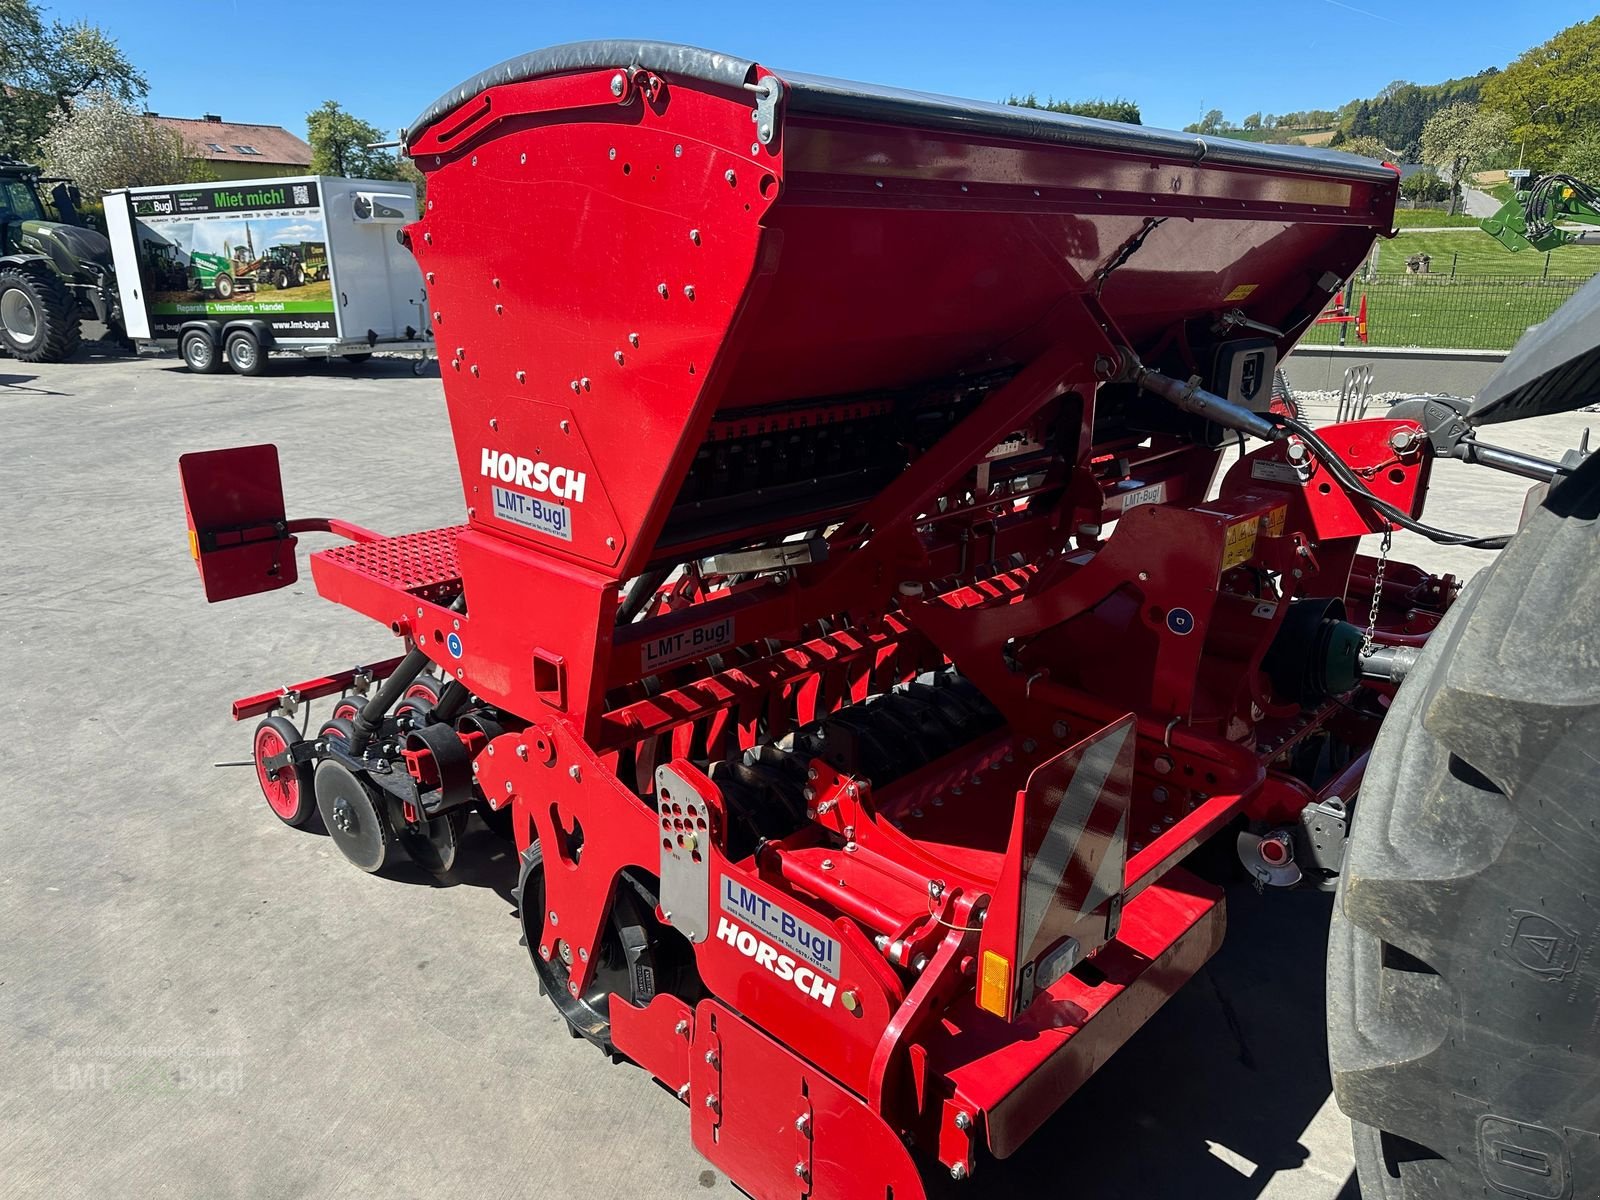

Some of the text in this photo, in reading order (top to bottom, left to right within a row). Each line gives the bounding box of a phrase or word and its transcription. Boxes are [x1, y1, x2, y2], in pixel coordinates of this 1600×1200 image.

[153, 199, 173, 214] Bugl
[214, 188, 285, 208] Miet mich!
[176, 304, 208, 314] Reparatur
[214, 303, 254, 313] Vermietung
[259, 303, 285, 311] Handel
[272, 320, 330, 330] www.lmt-bugl.at
[480, 447, 586, 503] HORSCH
[496, 488, 566, 531] LMT-Bugl
[1124, 486, 1160, 507] LMT-Bugl
[647, 619, 730, 661] LMT-Bugl
[727, 879, 833, 962] LMT-Bugl
[716, 916, 837, 1008] HORSCH
